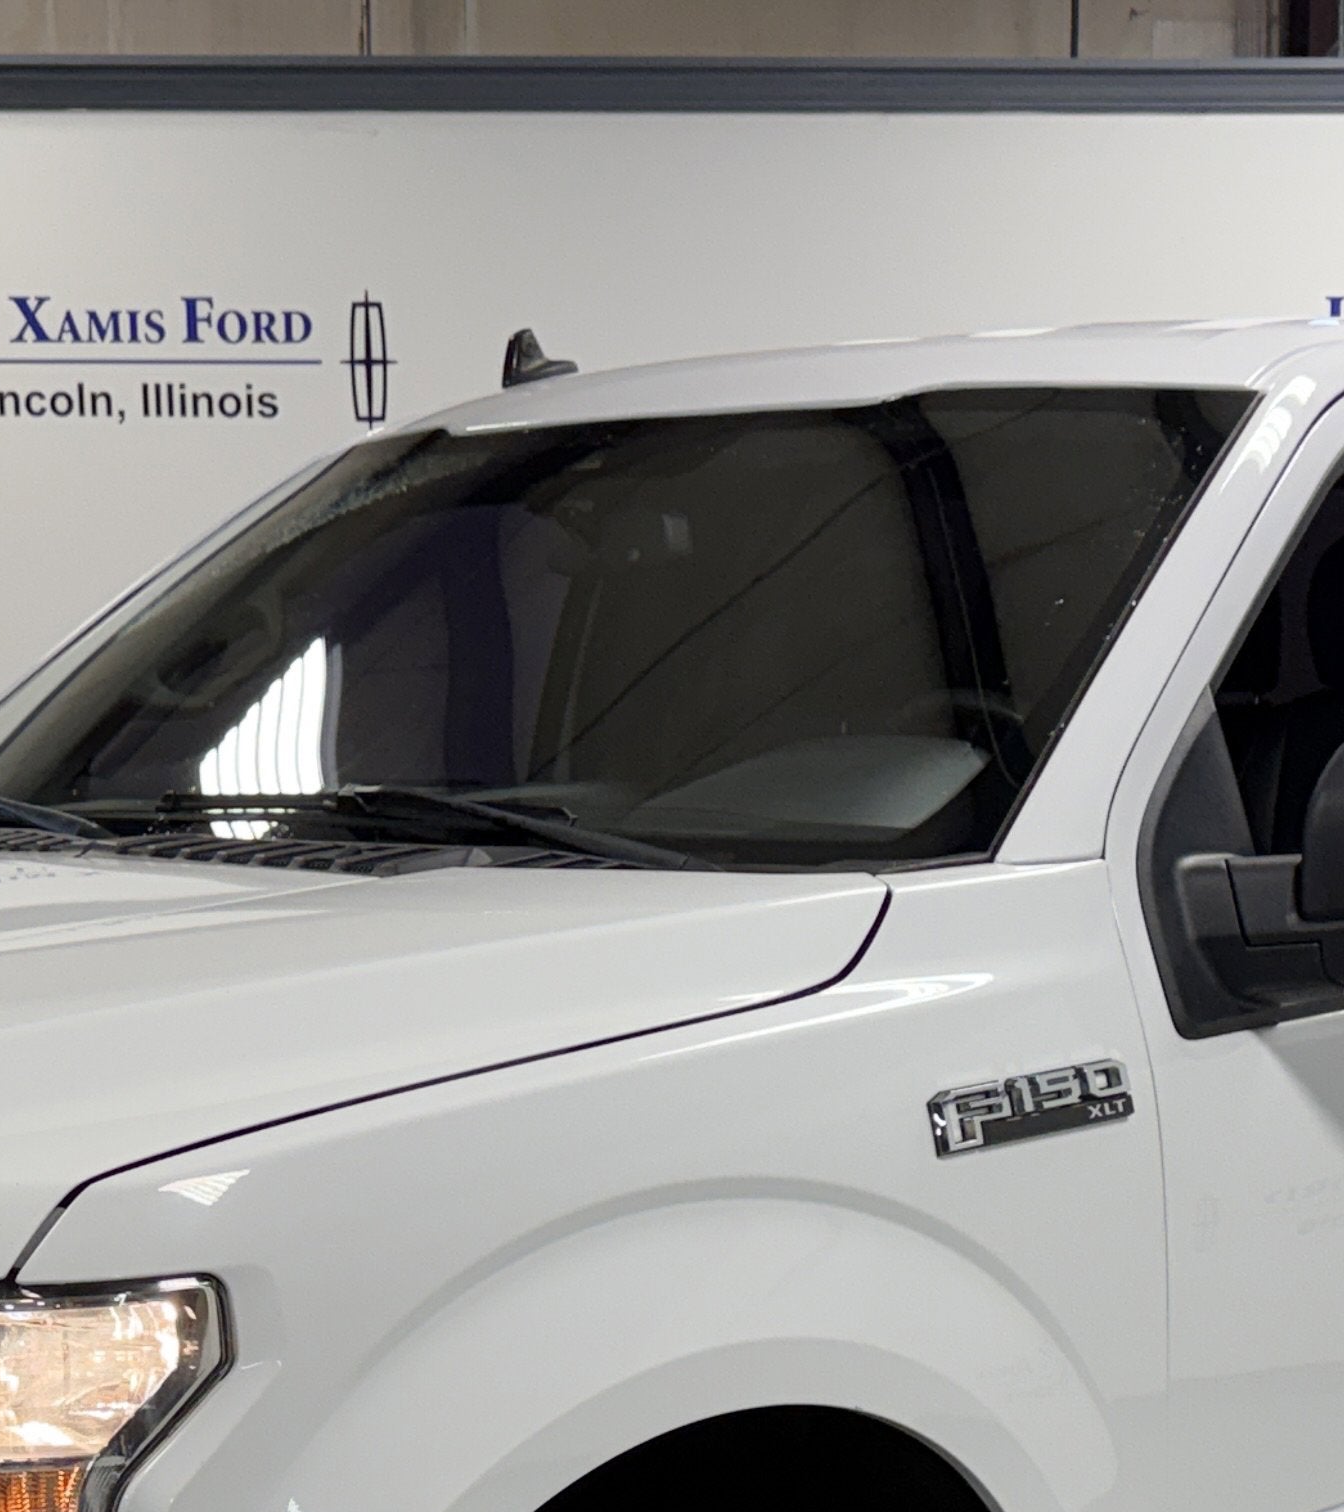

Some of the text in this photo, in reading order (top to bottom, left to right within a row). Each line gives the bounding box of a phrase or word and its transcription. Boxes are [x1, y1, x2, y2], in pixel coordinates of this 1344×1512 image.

[8, 296, 167, 343] XAMIS
[180, 296, 313, 343] FORD
[142, 382, 279, 418] Illinois
[1088, 1099, 1127, 1119] XLT
